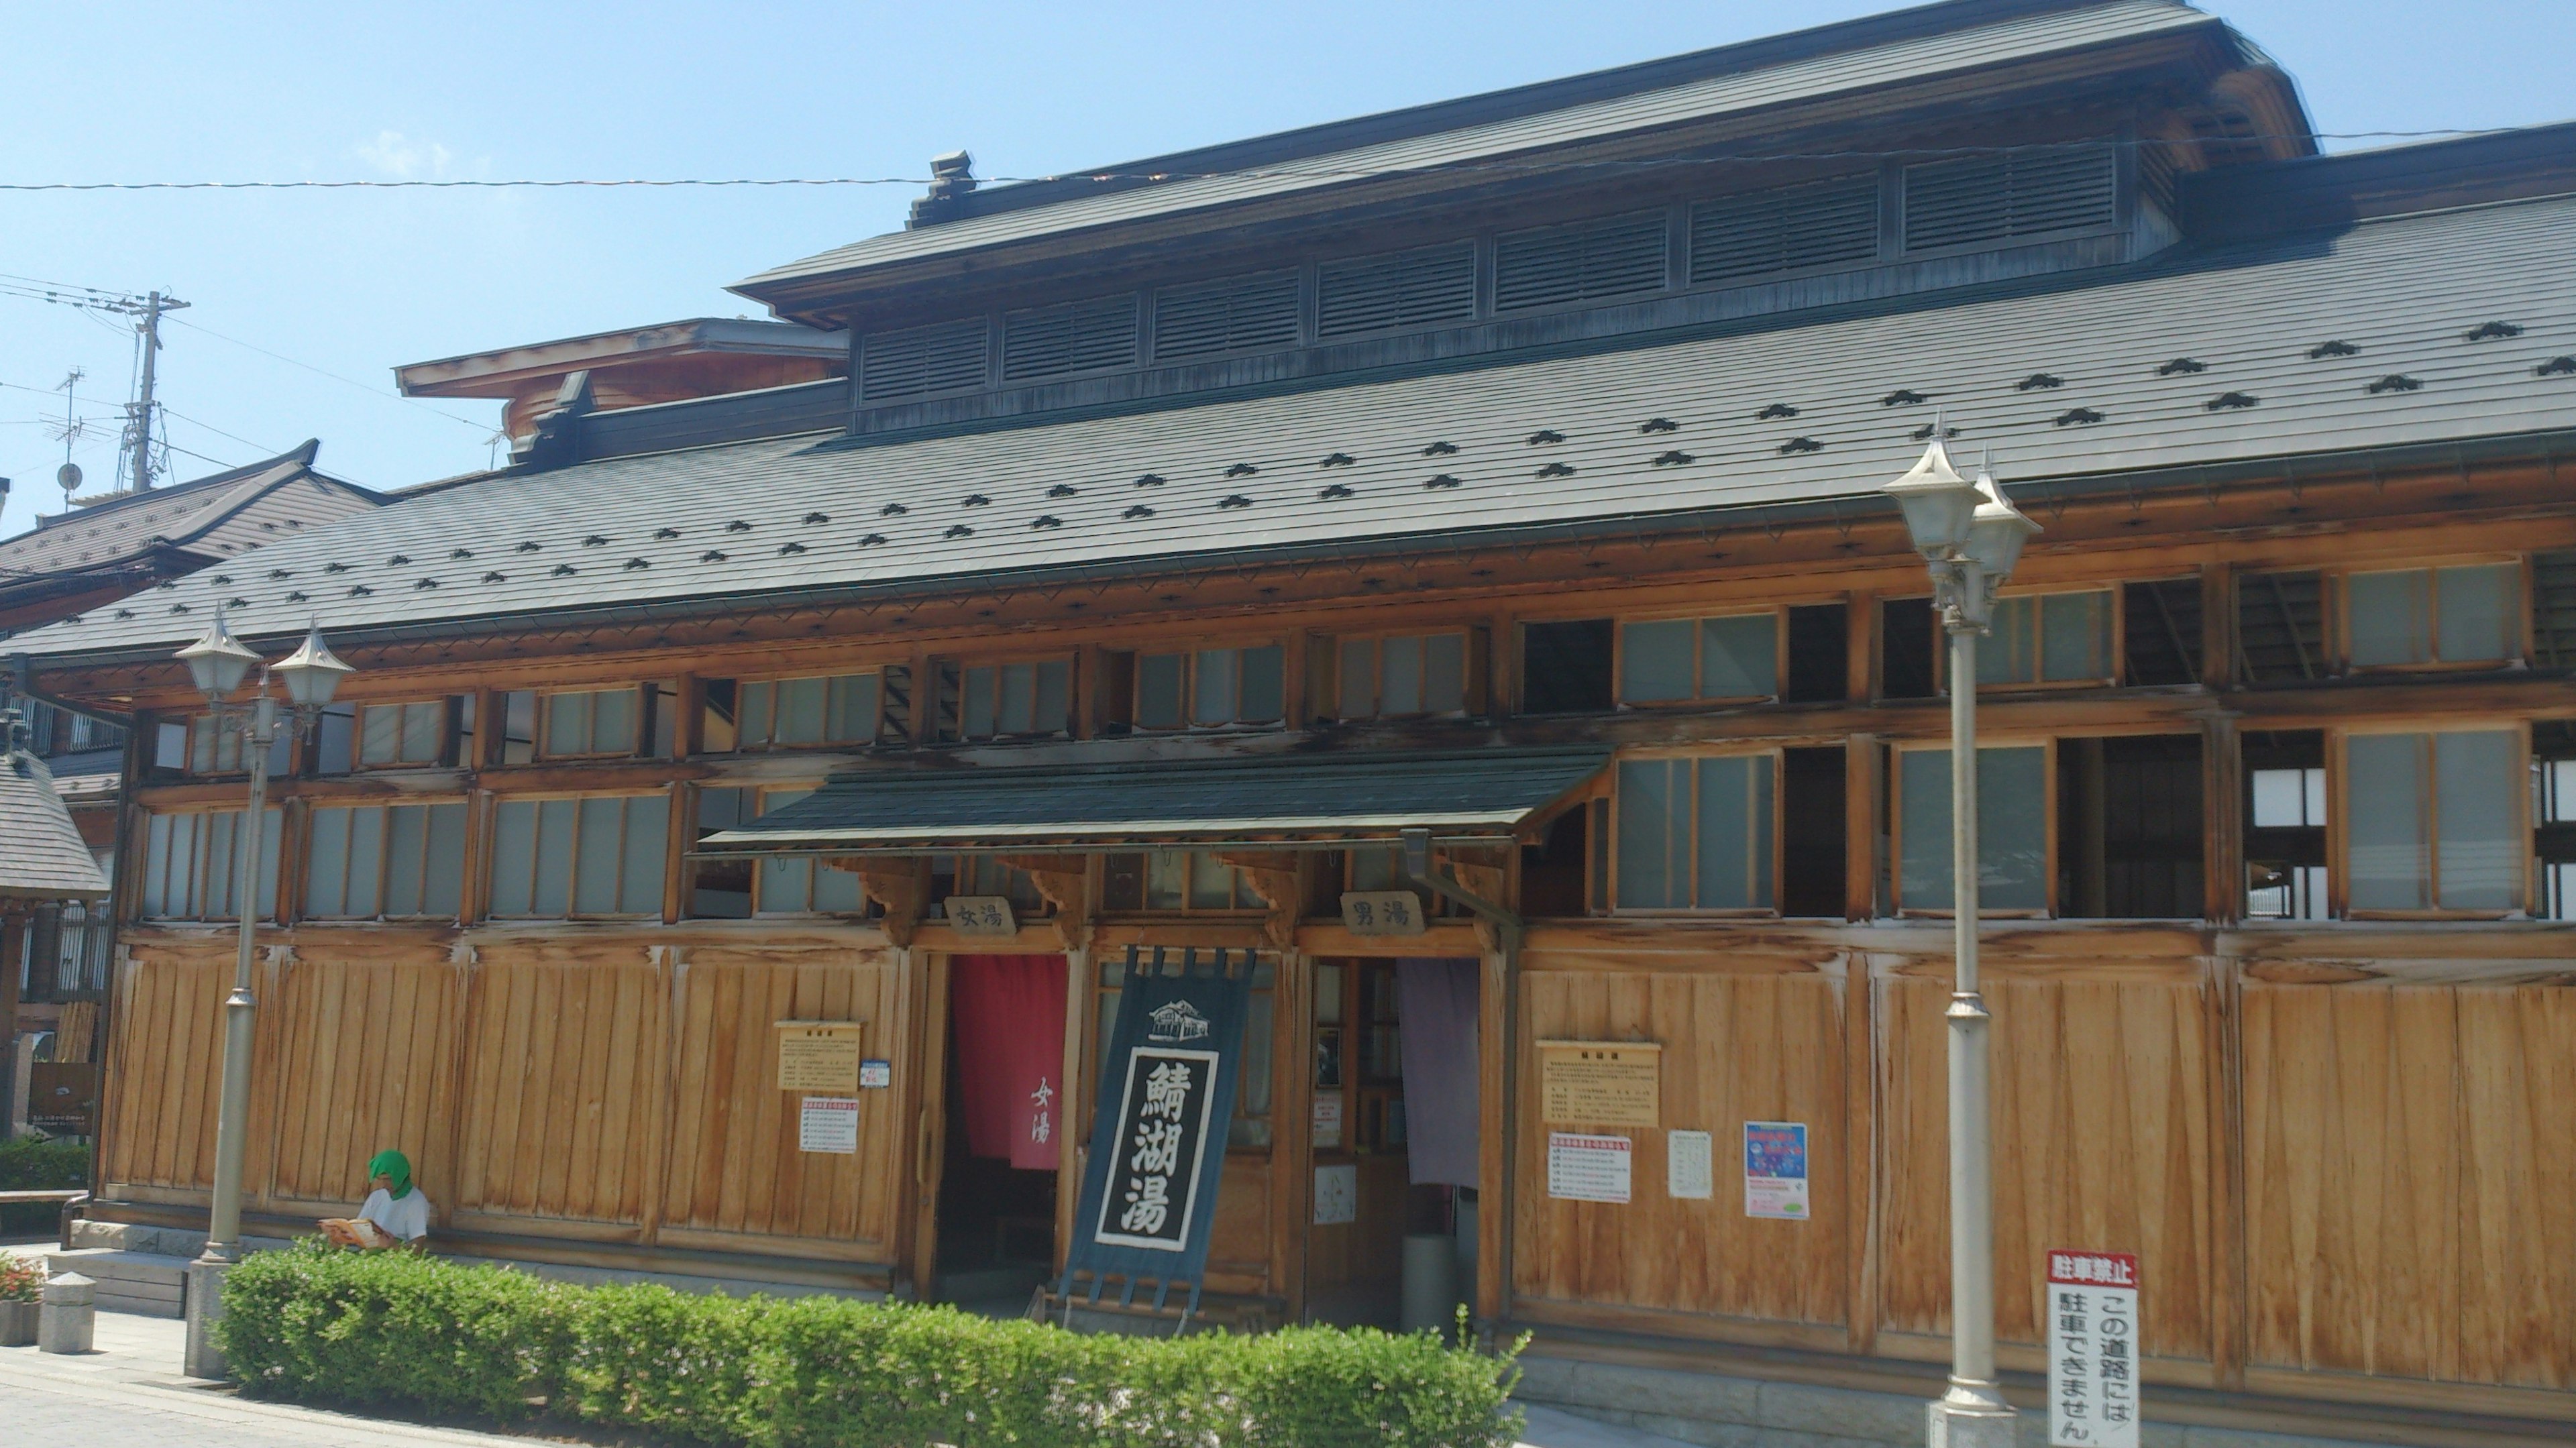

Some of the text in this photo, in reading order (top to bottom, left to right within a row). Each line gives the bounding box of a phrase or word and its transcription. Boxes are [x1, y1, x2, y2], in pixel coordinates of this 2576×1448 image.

[957, 904, 1002, 926] 女湯
[1354, 901, 1409, 926] 男湯
[1030, 1076, 1053, 1144] 女湯
[1120, 1061, 1191, 1235] 鯖湖湯
[2051, 1254, 2132, 1284] 駐車禁止
[2058, 1292, 2090, 1440] 駐車できません
[2100, 1296, 2131, 1423] この道路には
